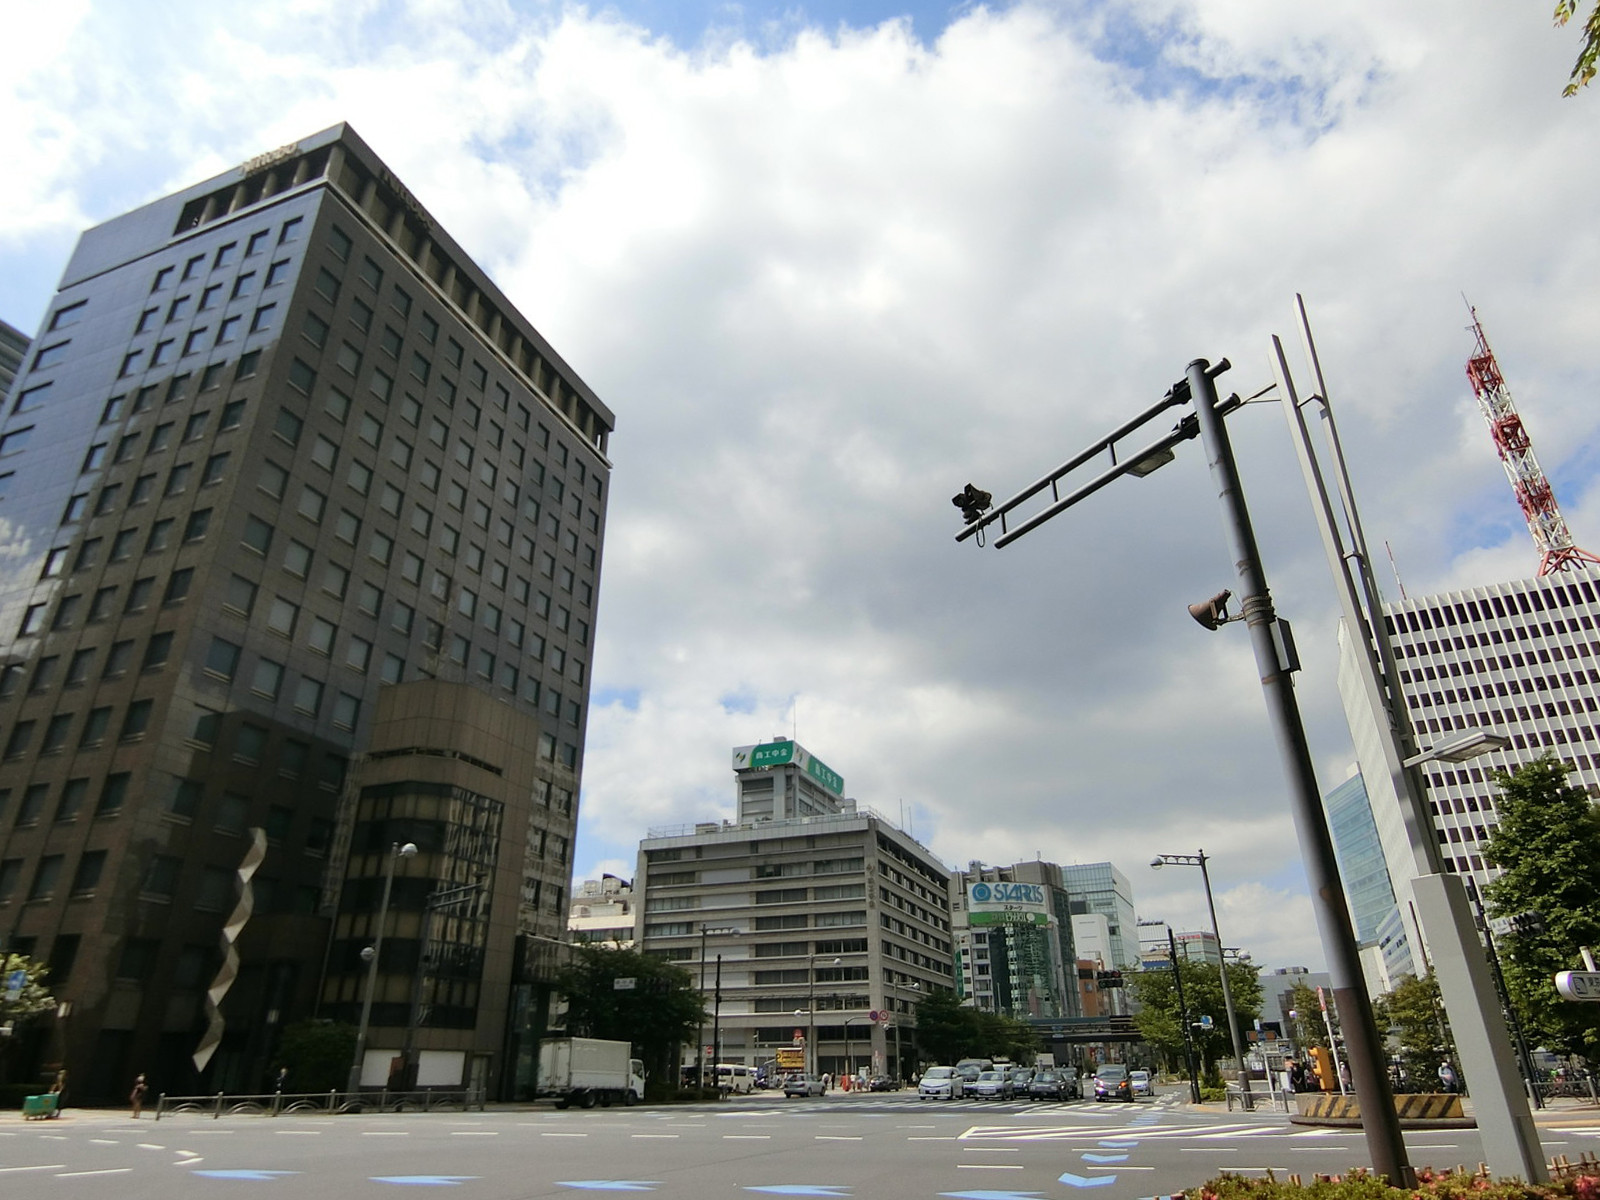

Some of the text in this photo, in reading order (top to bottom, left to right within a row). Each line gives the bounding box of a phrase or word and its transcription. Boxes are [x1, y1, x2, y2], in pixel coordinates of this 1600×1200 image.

[755, 749, 788, 760] 商工中金
[993, 883, 1044, 903] STARTS
